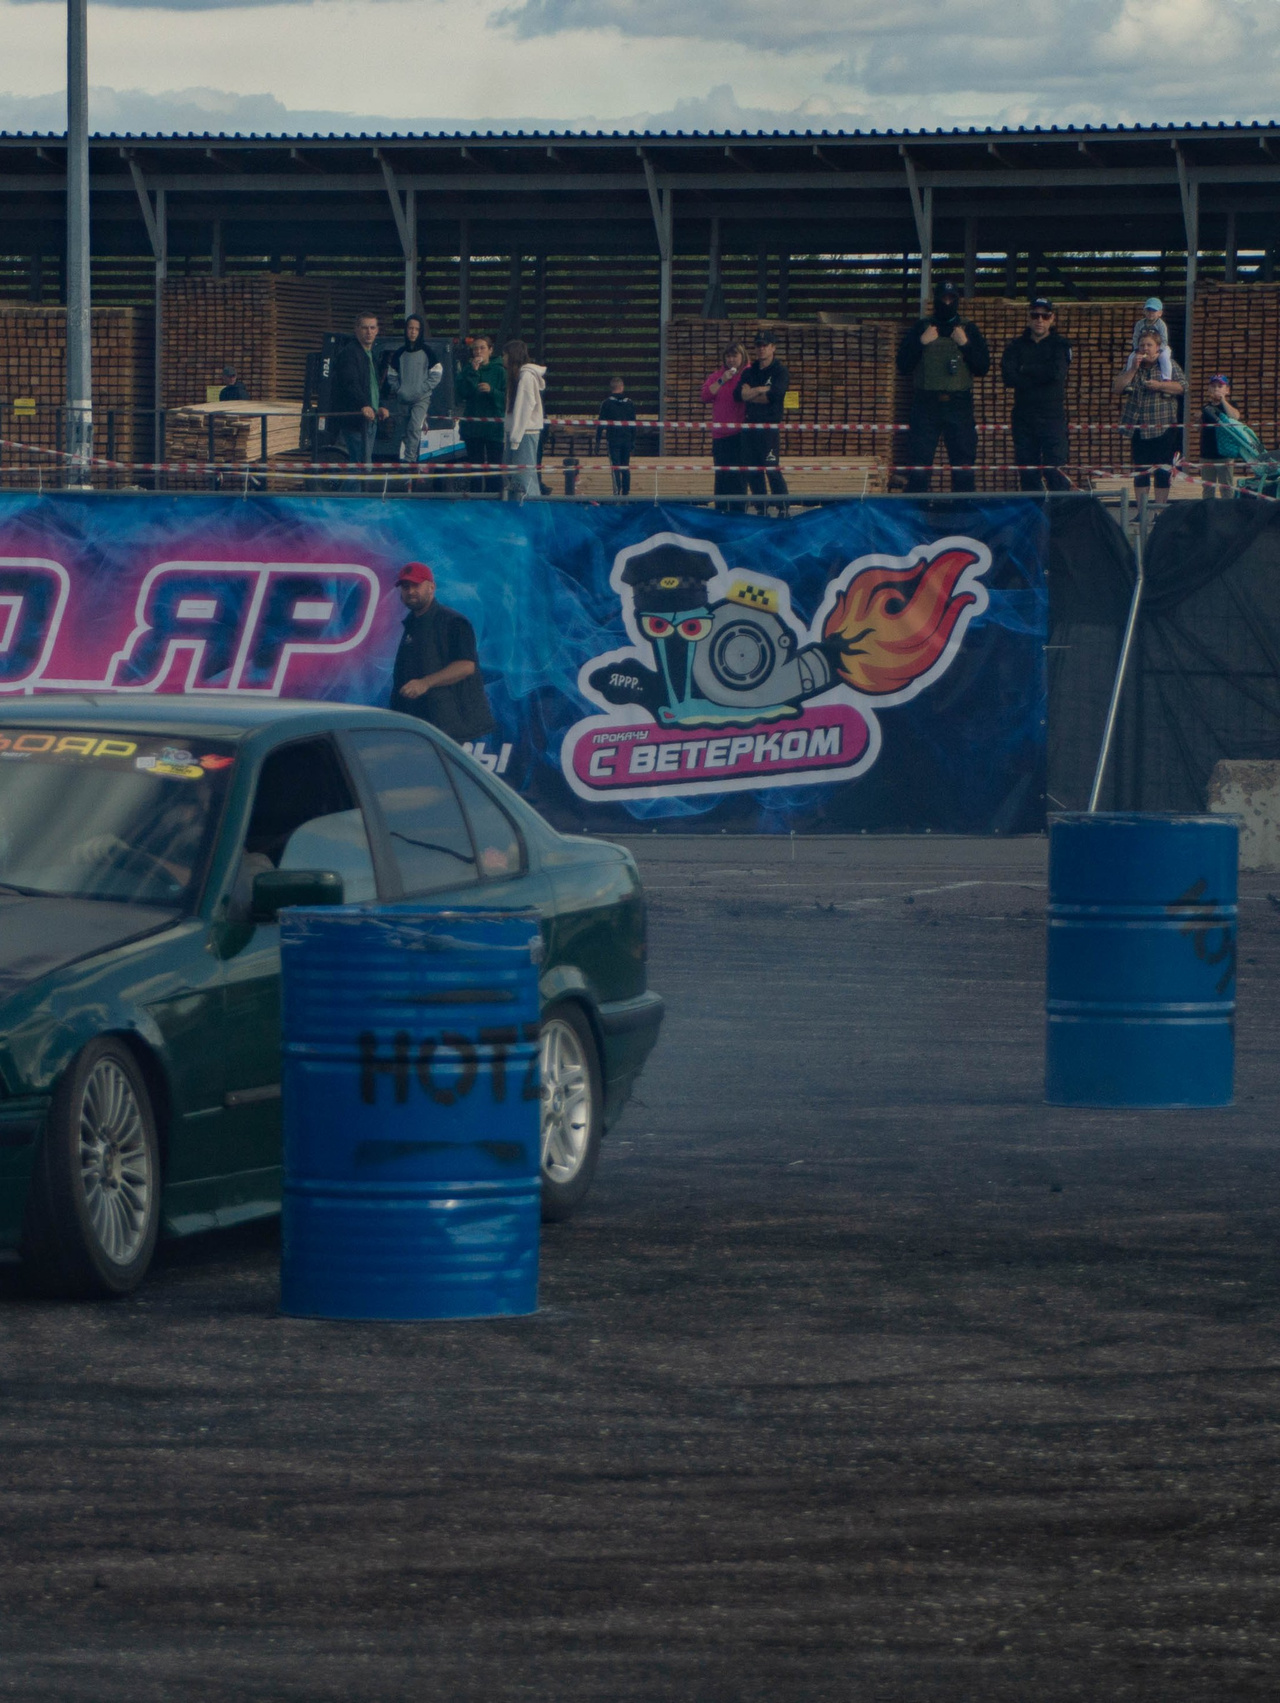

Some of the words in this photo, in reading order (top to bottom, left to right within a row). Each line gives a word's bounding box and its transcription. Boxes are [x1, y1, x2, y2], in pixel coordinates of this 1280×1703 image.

[589, 747, 618, 777] С
[627, 727, 841, 775] ВЕТЕРКОМ
[592, 730, 650, 744] ПРОКАЧУ
